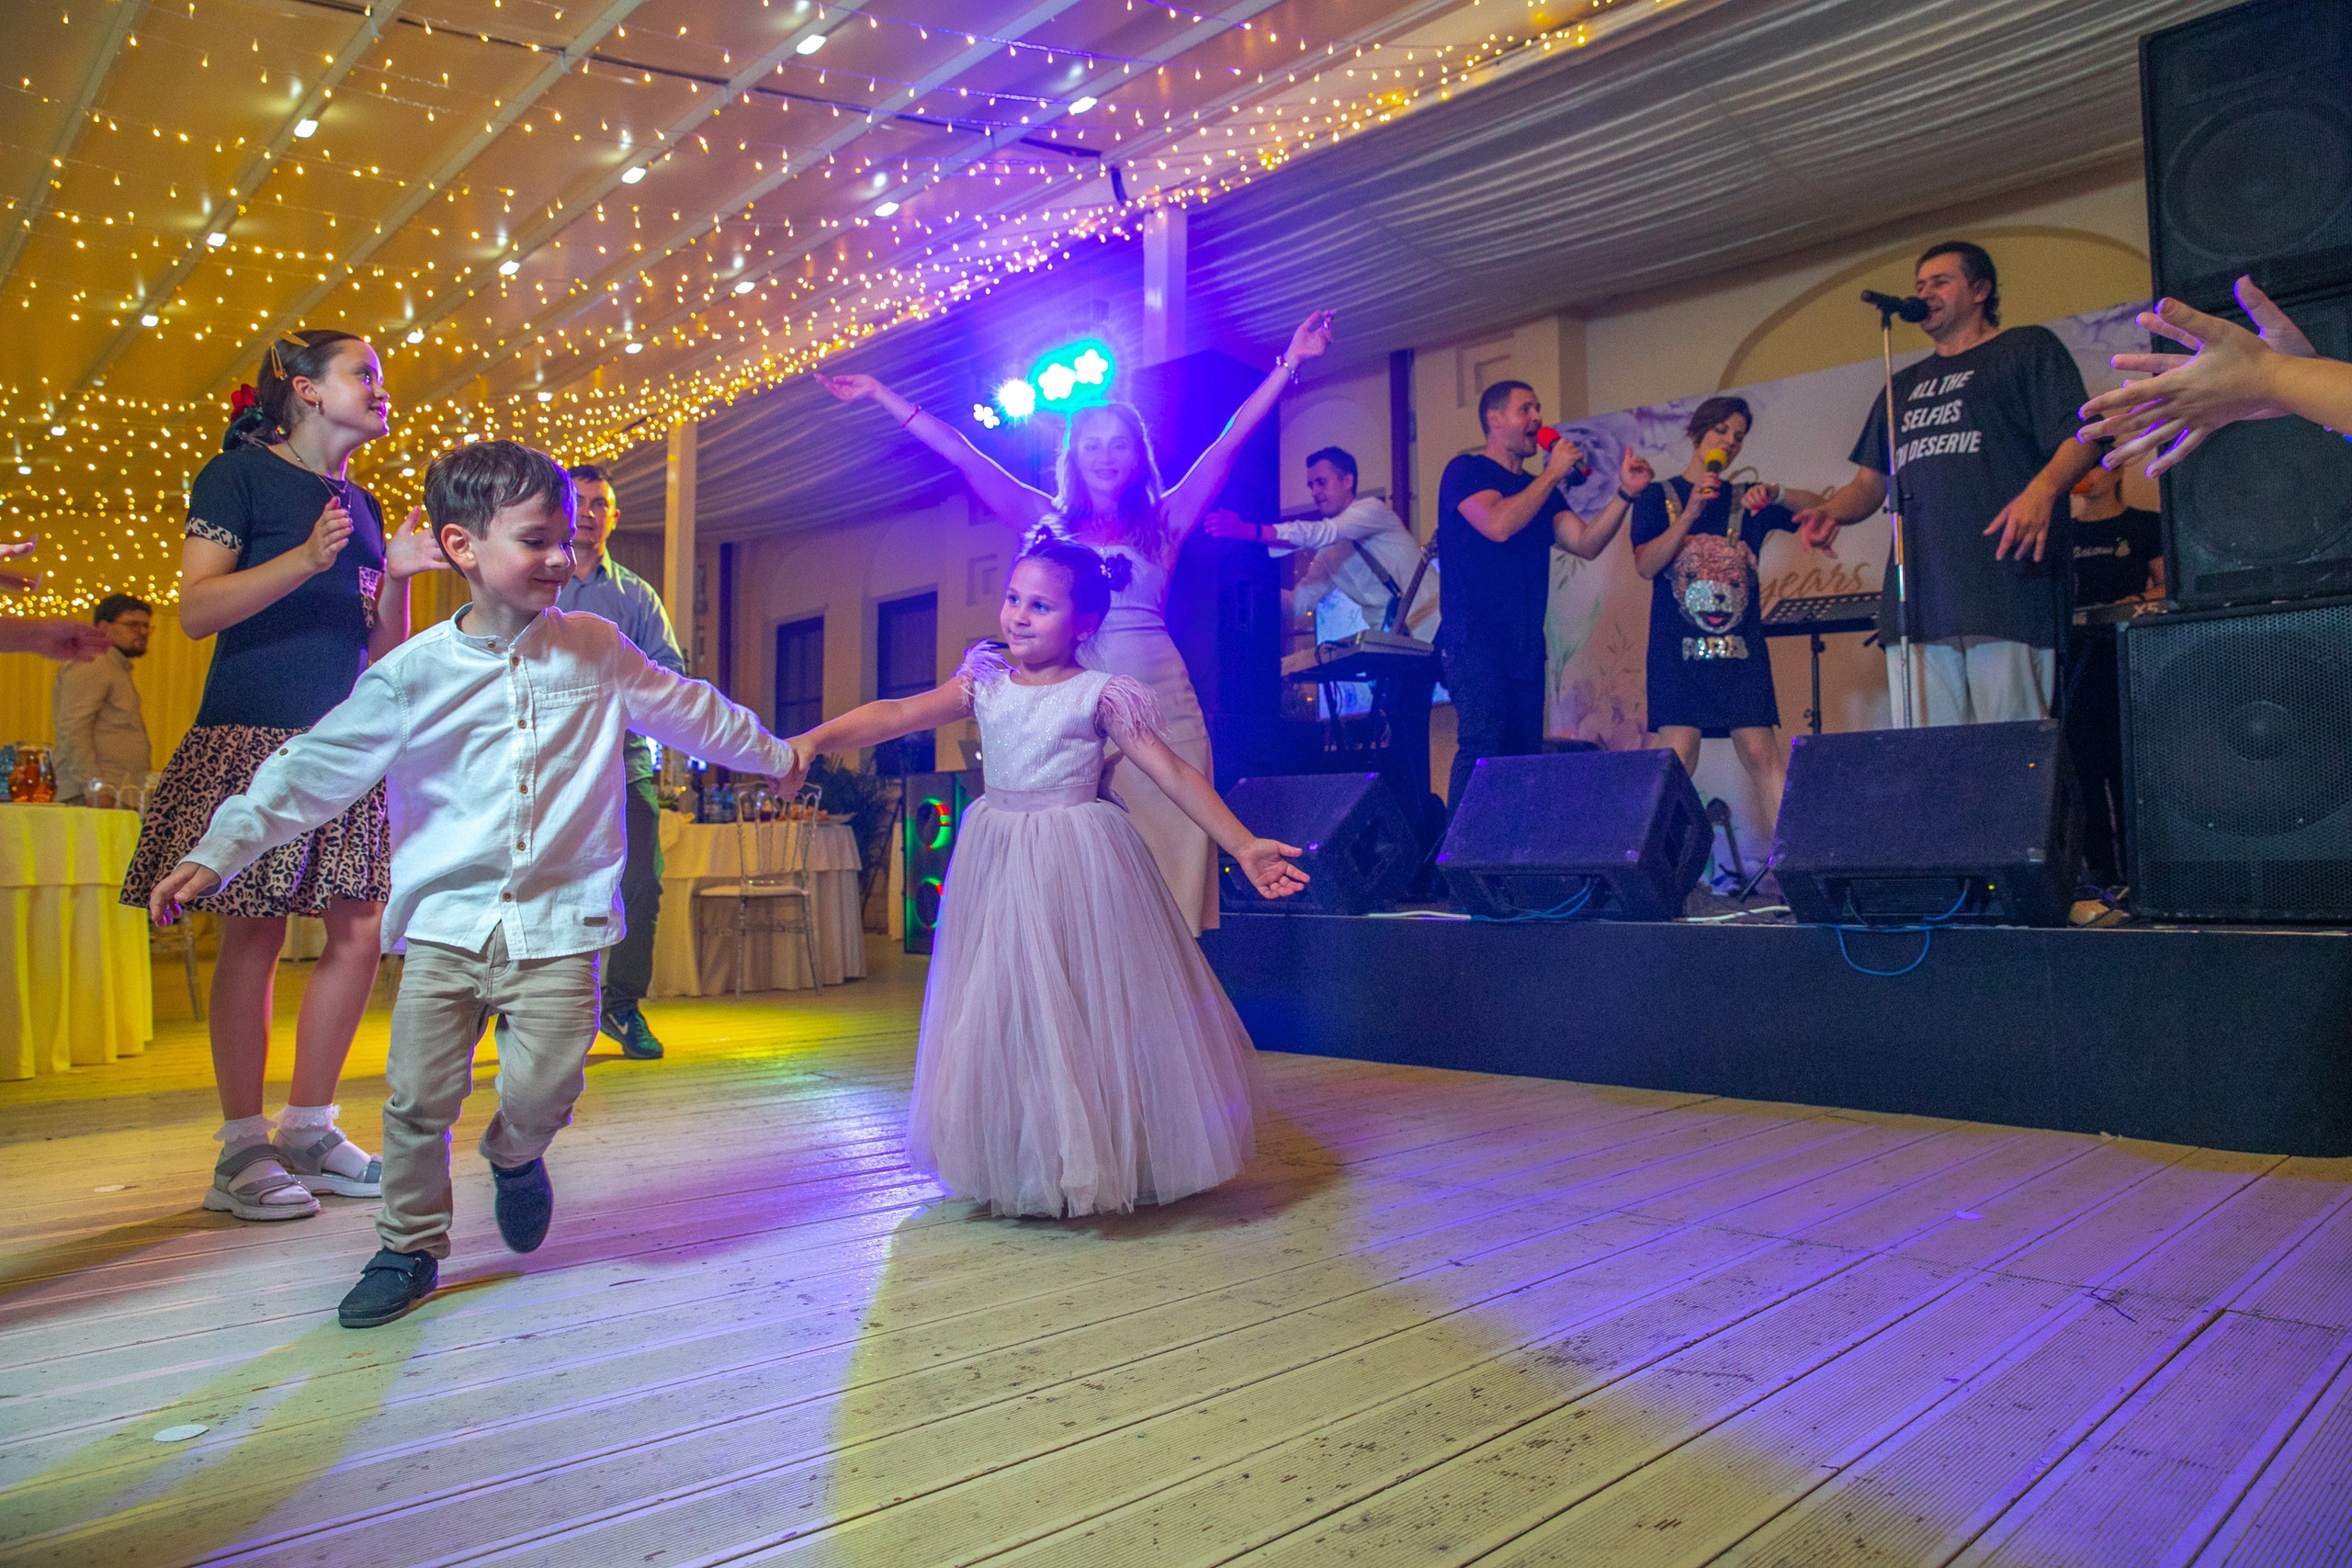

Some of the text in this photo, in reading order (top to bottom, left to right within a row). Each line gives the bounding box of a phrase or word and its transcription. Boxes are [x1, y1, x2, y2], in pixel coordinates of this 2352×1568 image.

[1907, 370, 1974, 401] ALL THE
[1901, 399, 1963, 433] SELFIES
[1907, 430, 1983, 462] DESERVE
